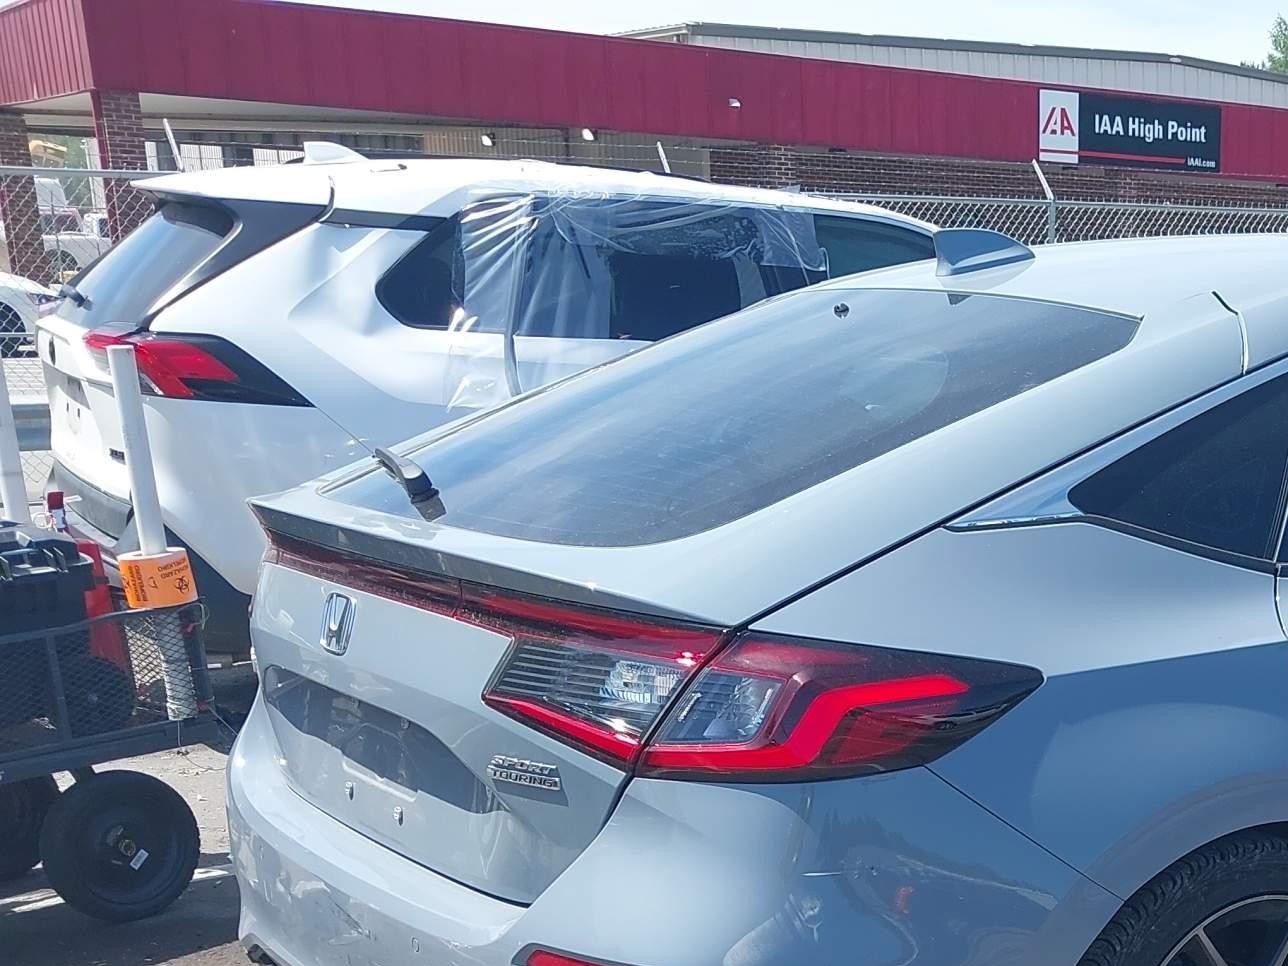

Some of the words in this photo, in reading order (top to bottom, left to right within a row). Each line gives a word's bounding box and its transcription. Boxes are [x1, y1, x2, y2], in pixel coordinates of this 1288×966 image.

[1094, 113, 1125, 136] IAA
[1128, 116, 1163, 143] High
[1167, 120, 1207, 144] Point
[490, 755, 557, 775] SPORT
[487, 766, 559, 789] TOURING
